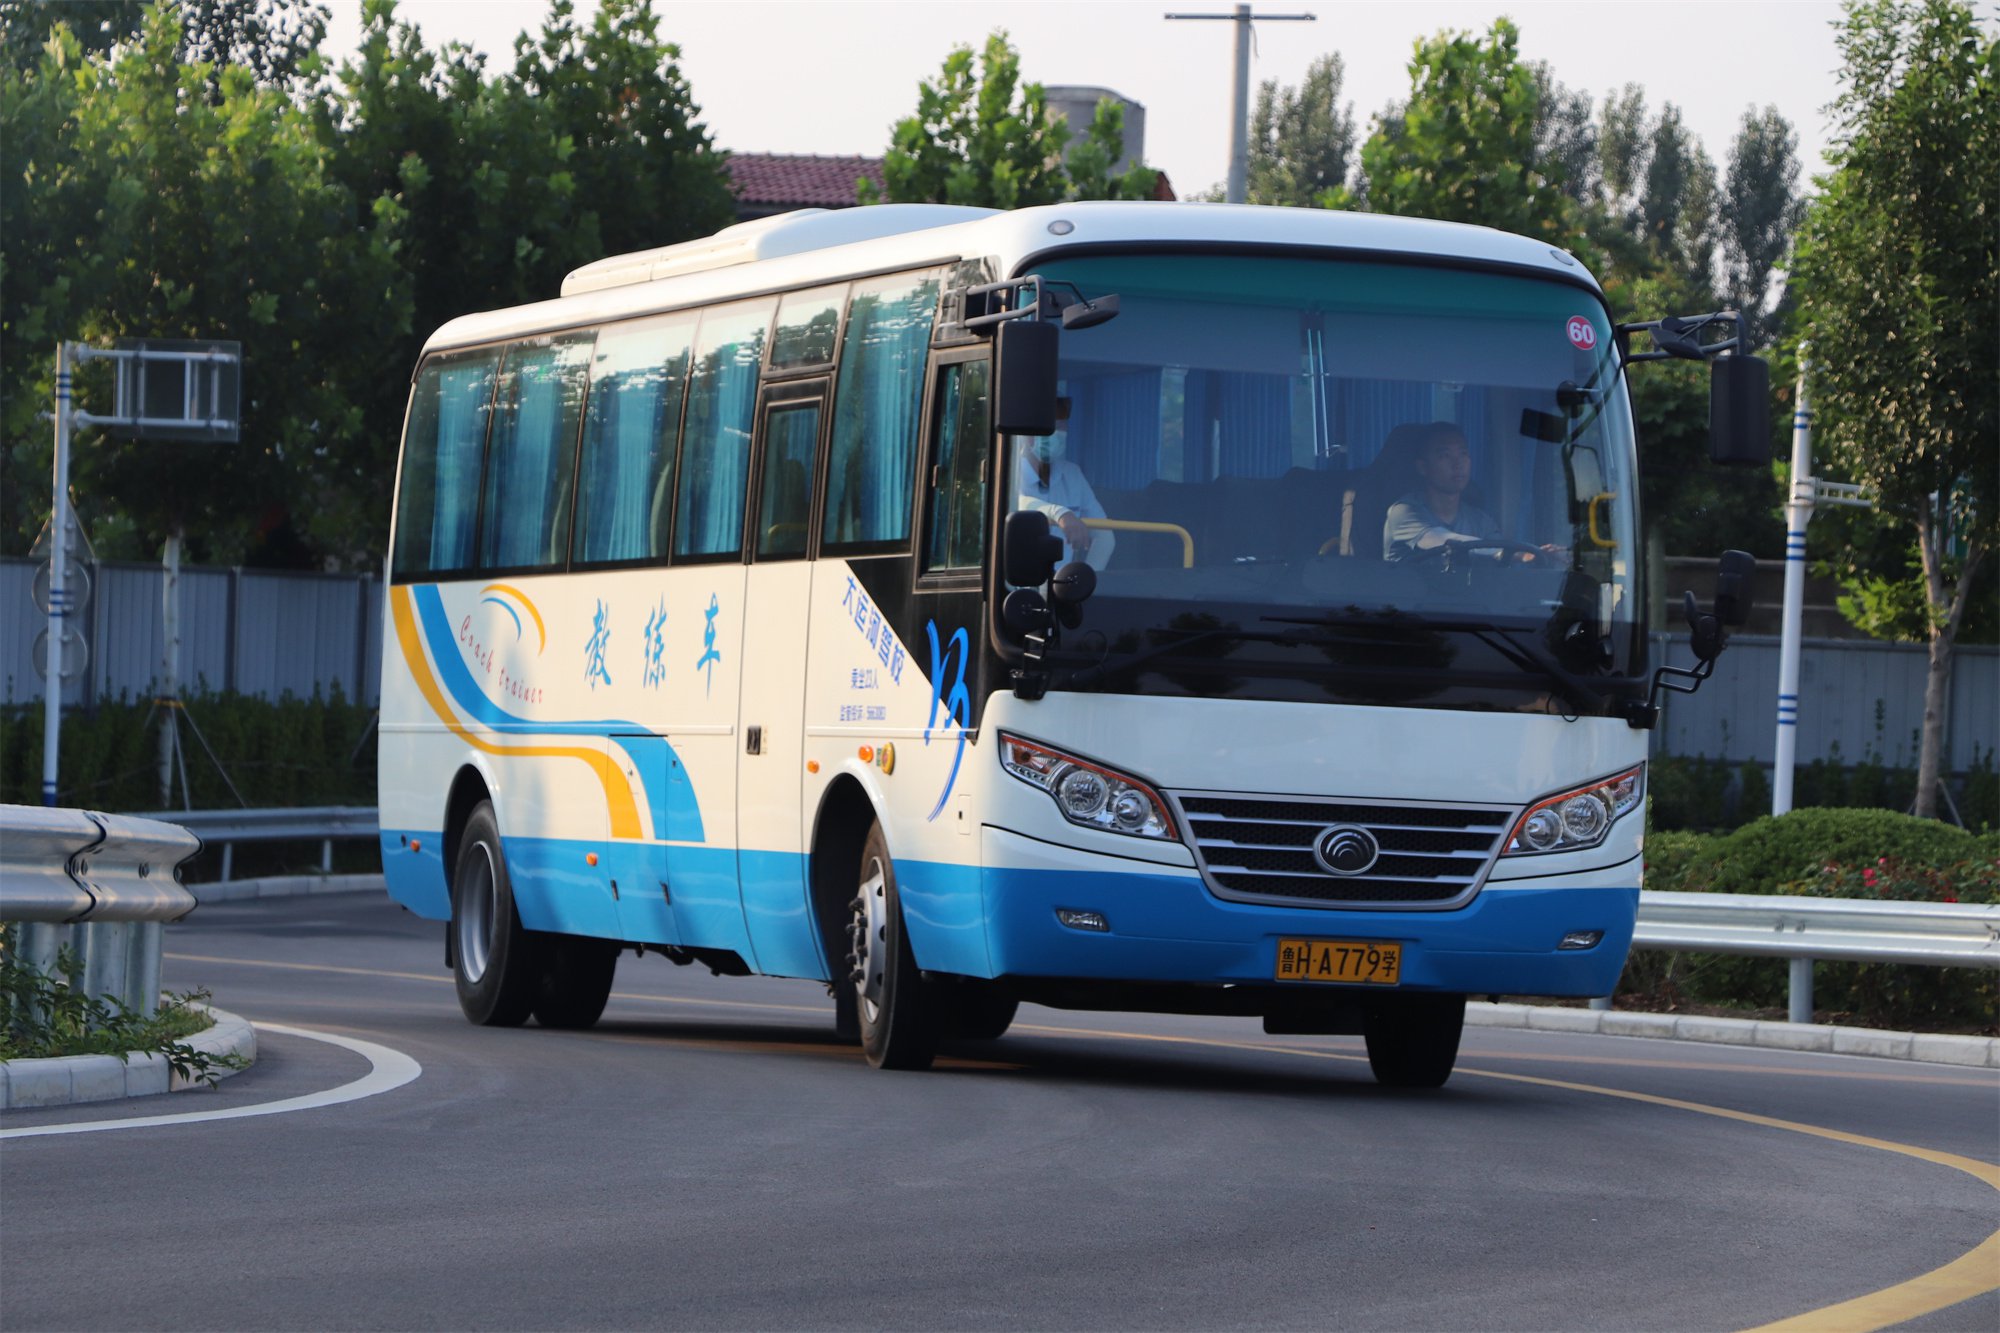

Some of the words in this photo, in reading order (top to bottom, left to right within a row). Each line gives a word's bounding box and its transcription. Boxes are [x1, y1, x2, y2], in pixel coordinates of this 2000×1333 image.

[1569, 321, 1595, 344] 60
[460, 614, 494, 673] Coach
[498, 667, 543, 704] trainer
[584, 591, 721, 702] 教练车
[842, 575, 905, 686] 大运河驾校
